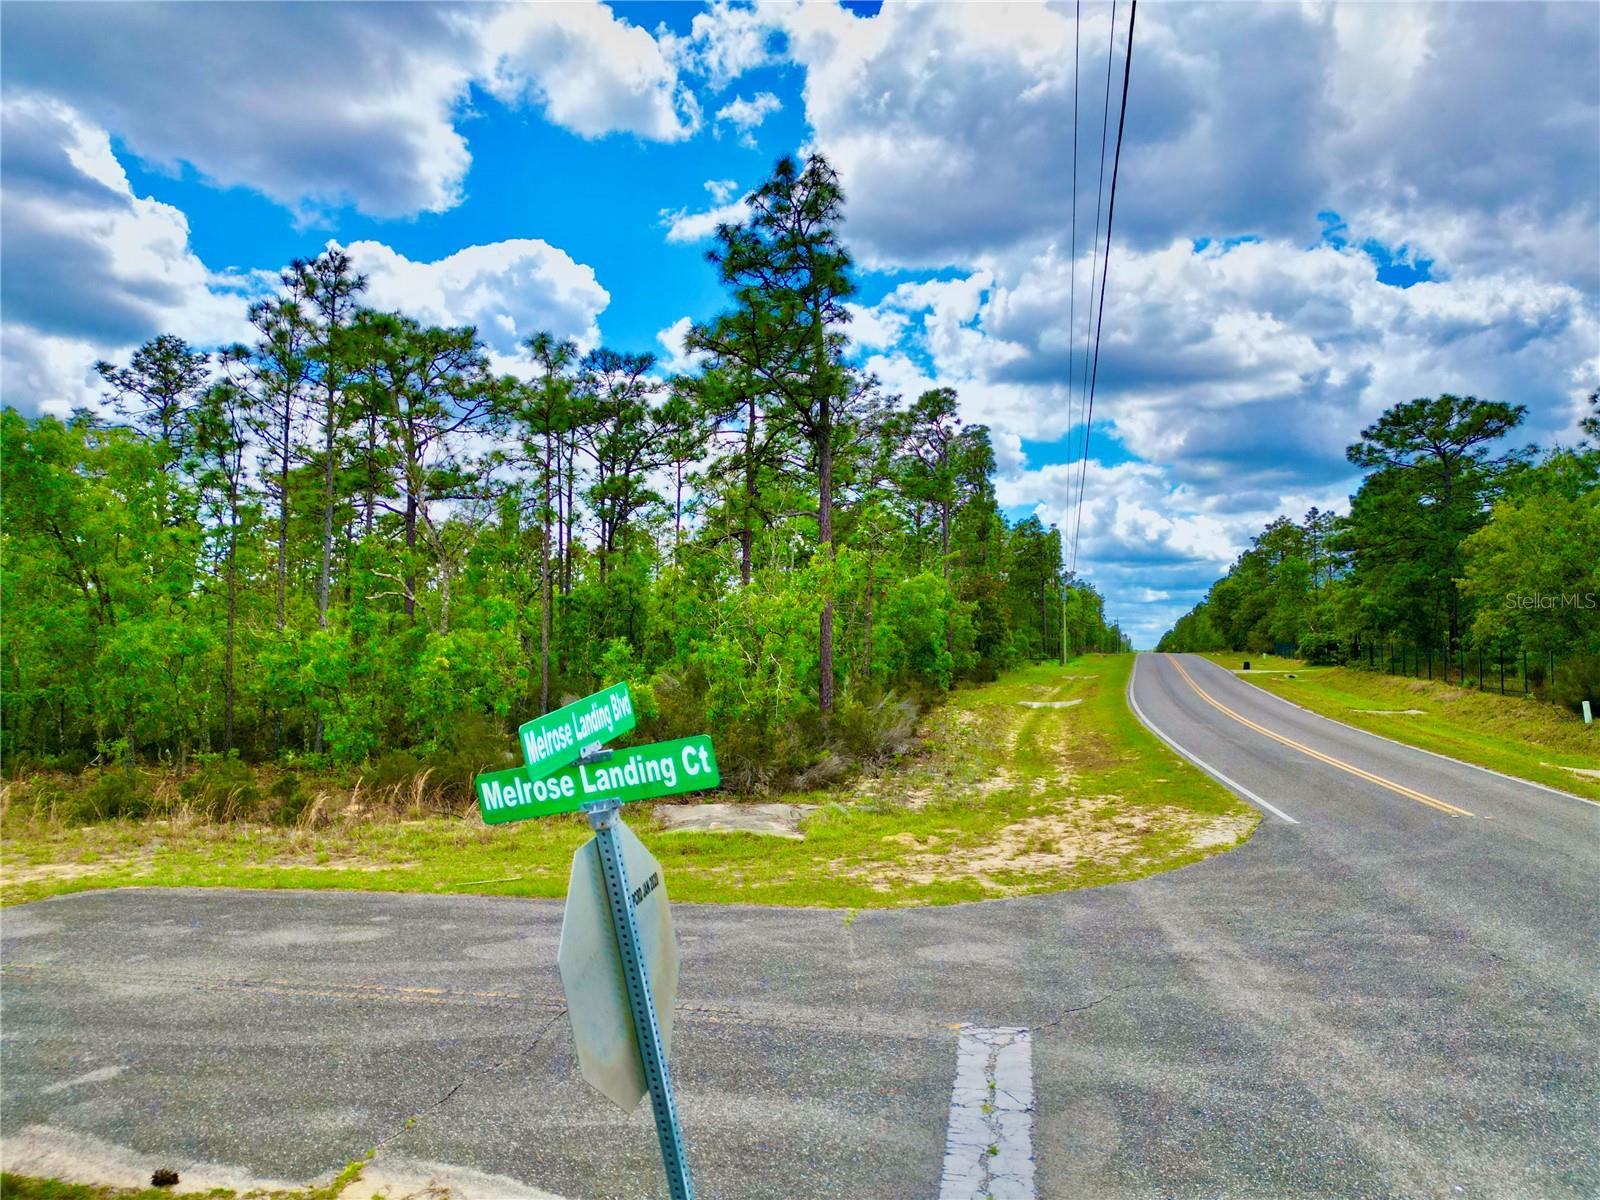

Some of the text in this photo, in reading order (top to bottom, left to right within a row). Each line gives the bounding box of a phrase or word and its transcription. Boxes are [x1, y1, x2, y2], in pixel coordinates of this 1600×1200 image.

[524, 690, 631, 764] Melrose Landing Blvd
[481, 744, 712, 811] Melrose Landing Ct
